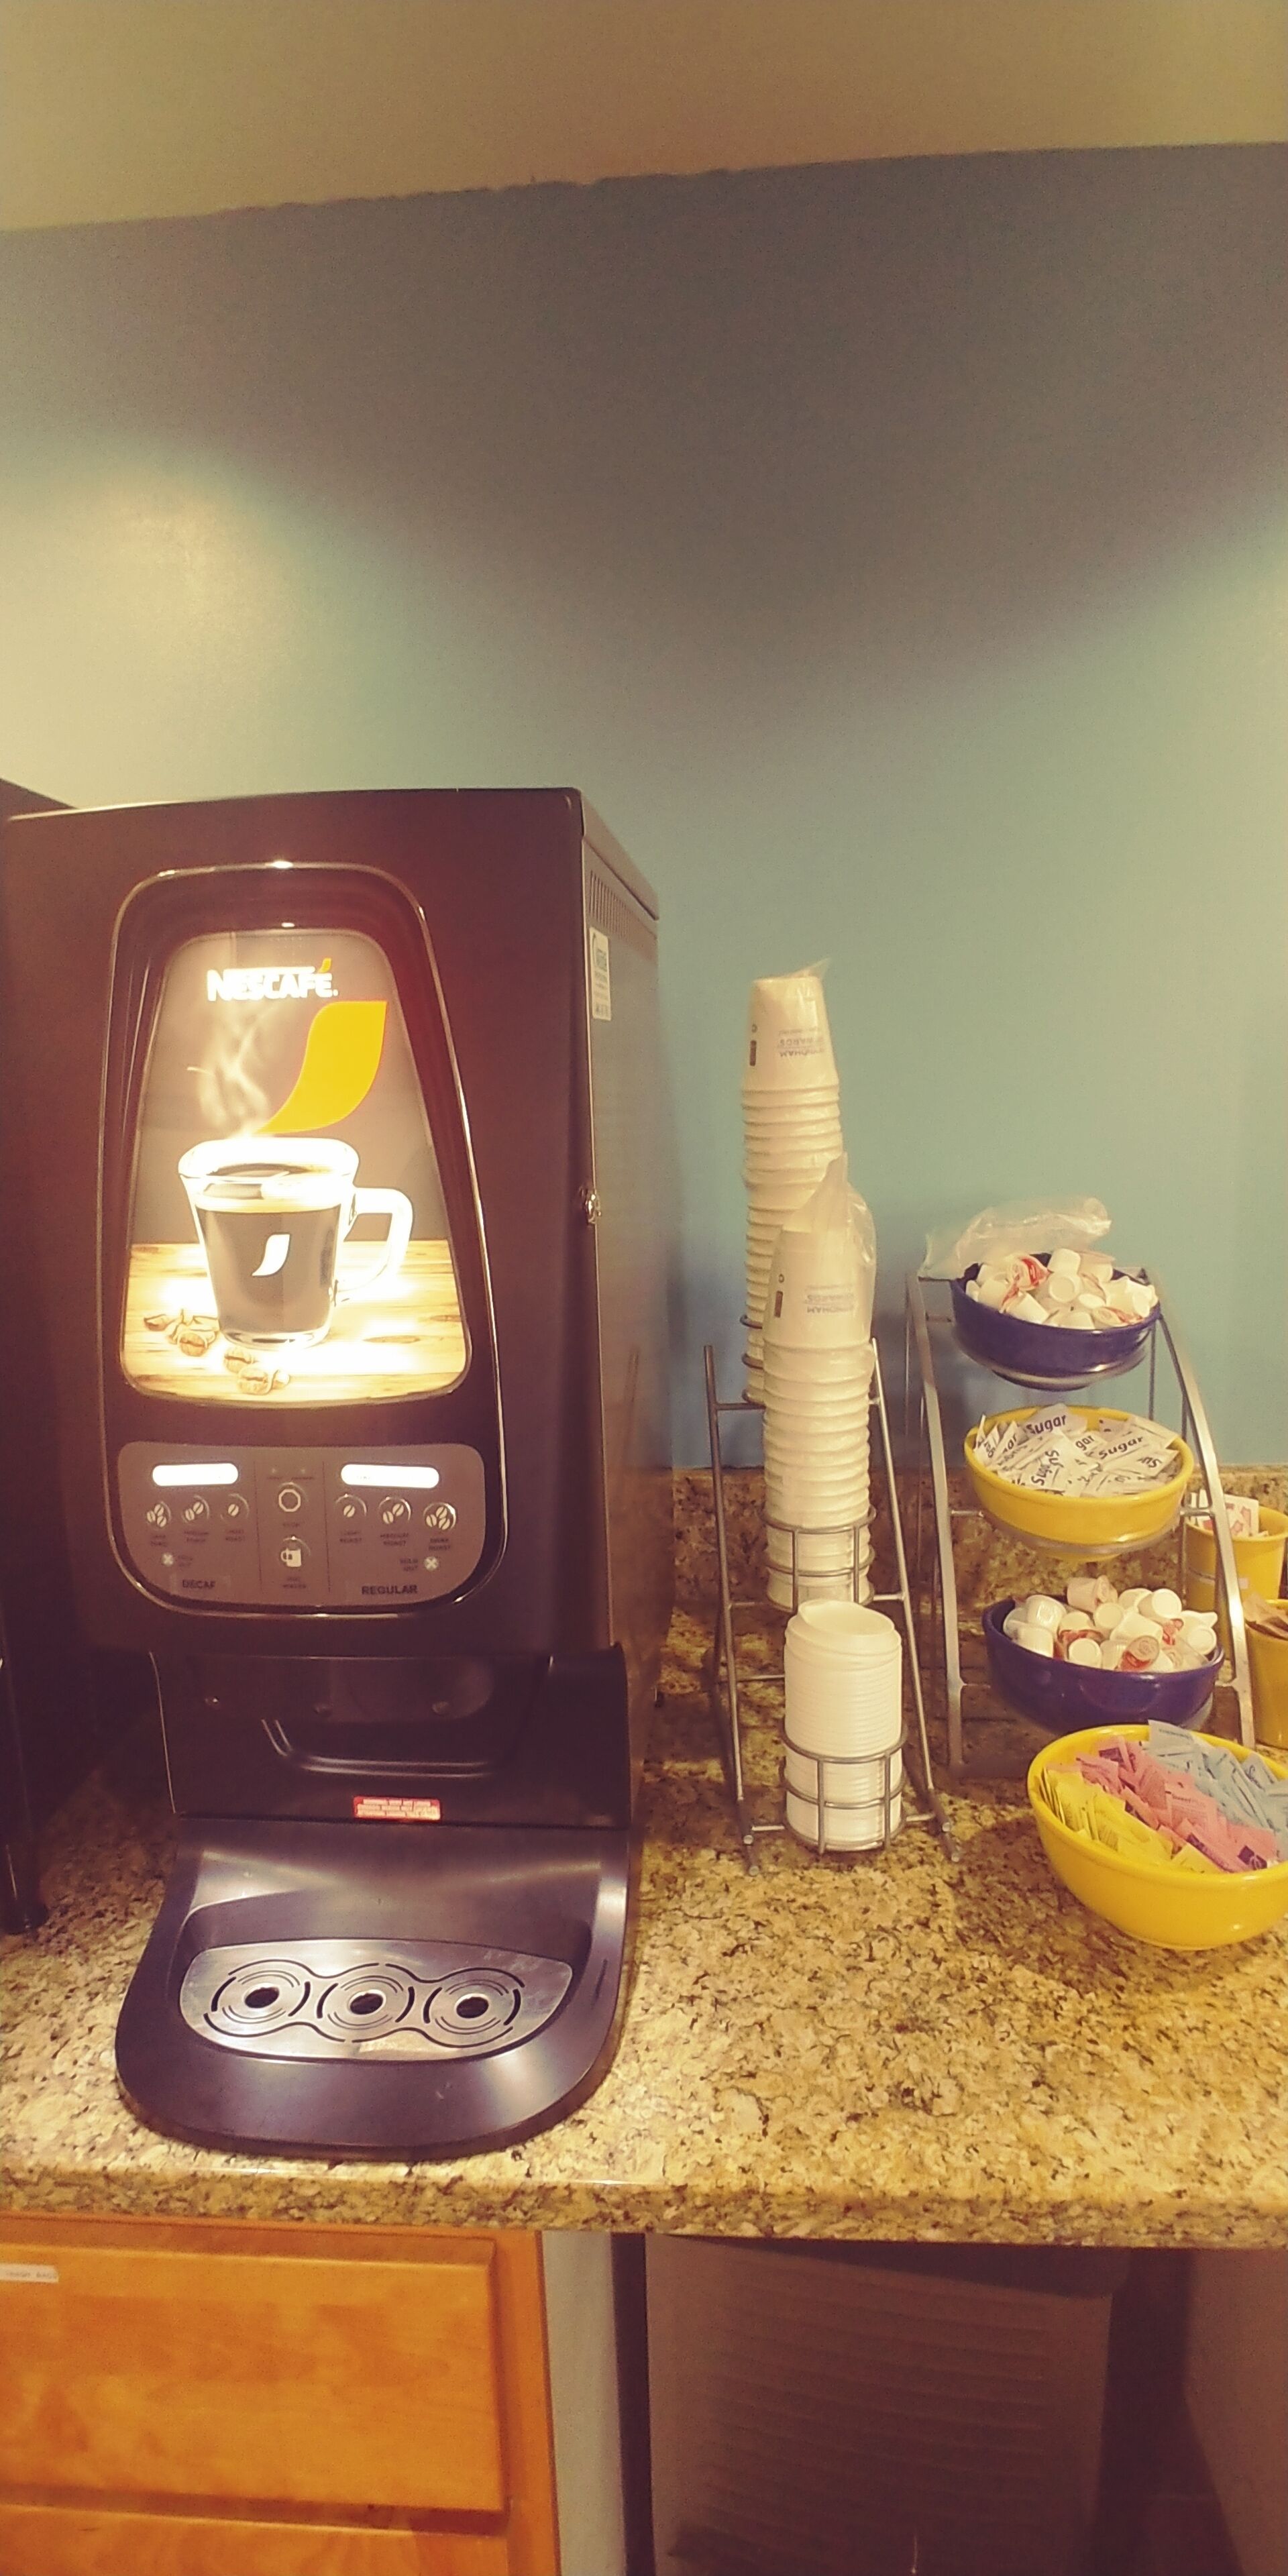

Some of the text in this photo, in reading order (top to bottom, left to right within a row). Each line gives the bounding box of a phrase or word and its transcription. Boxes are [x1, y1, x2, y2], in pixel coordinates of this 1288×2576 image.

[1026, 1415, 1067, 1434] Sugar
[1098, 1436, 1144, 1460] Sugar
[361, 1585, 418, 1595] REGULAR
